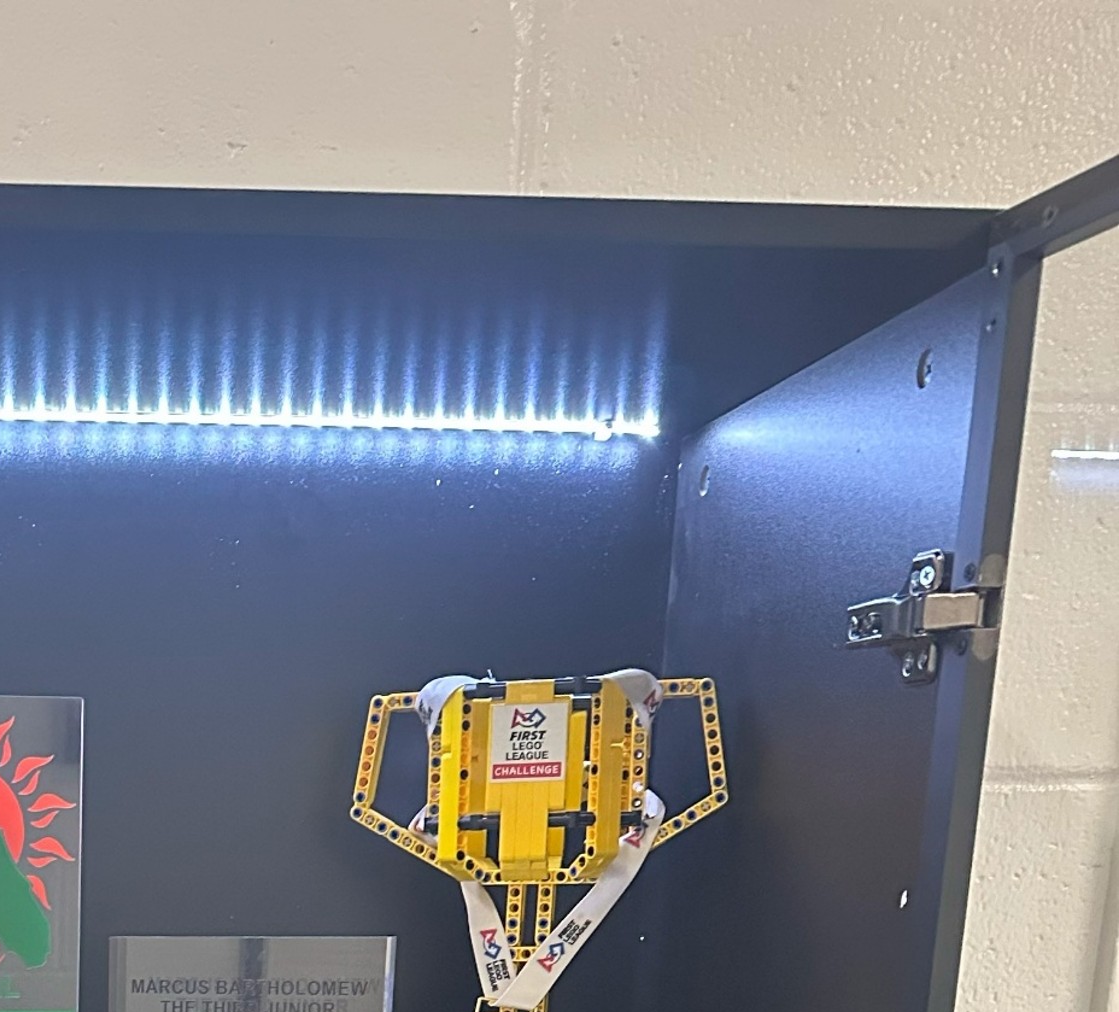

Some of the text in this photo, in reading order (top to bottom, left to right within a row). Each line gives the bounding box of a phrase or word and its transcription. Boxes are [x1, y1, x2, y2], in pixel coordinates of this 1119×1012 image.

[510, 730, 546, 741] FIRST
[512, 742, 542, 750] LEGO
[506, 751, 548, 760] LEAGUE
[494, 765, 559, 776] CHALLENGE
[131, 979, 368, 996] MARCUS BARTHOLOMEW
